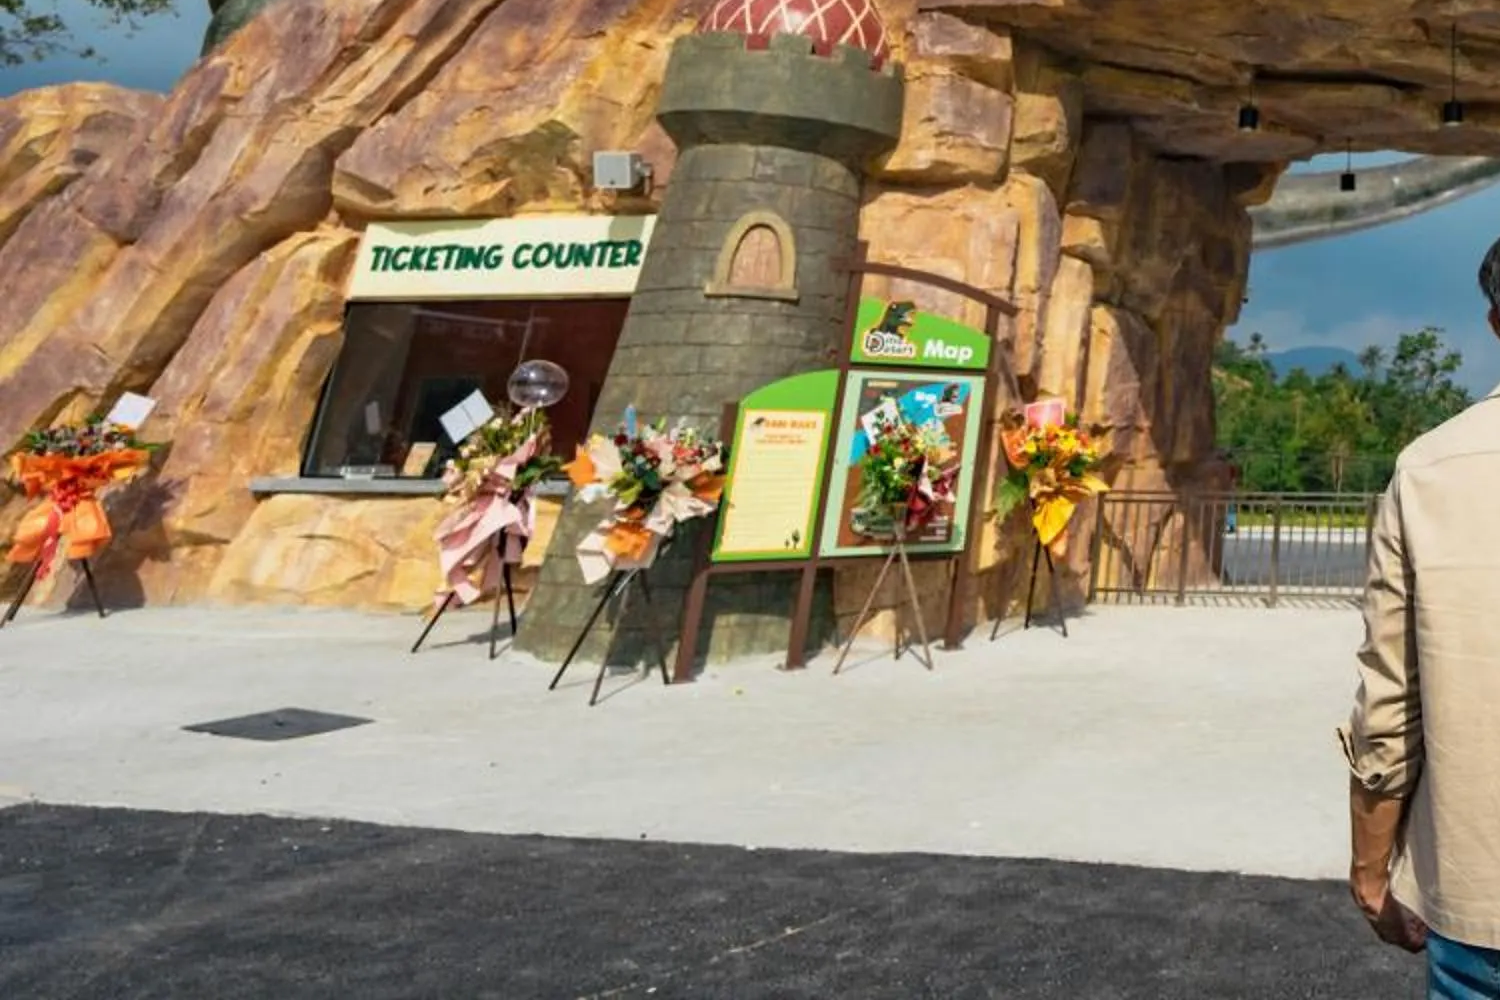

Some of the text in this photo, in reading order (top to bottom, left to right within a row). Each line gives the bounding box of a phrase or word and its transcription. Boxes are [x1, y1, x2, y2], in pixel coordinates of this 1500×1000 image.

[370, 239, 643, 272] TICKETING COUNTER
[923, 339, 973, 365] Map
